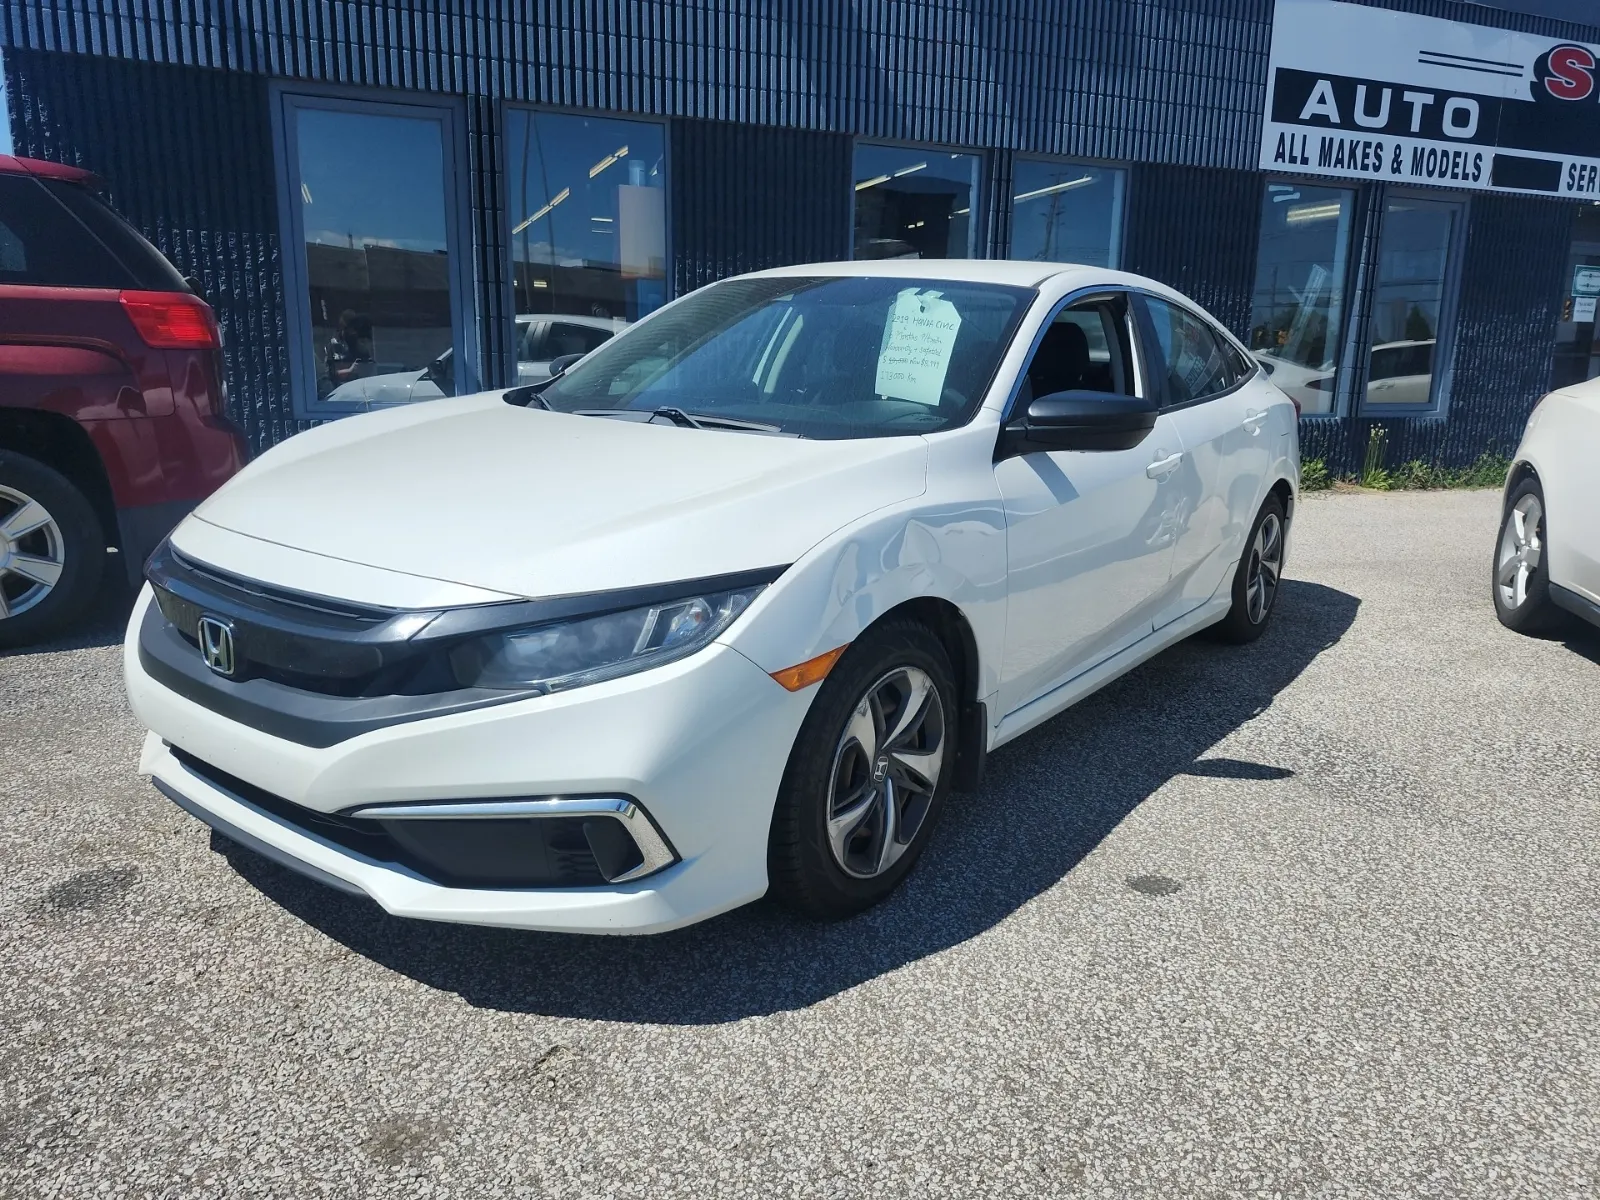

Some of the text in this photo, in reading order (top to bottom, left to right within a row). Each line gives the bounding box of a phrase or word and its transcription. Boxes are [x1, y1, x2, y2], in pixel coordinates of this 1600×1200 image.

[1545, 46, 1600, 103] S
[1299, 79, 1480, 139] AUTO
[1274, 132, 1600, 193] ALL MAKES & MODELS SER
[936, 320, 955, 331] CIVIC
